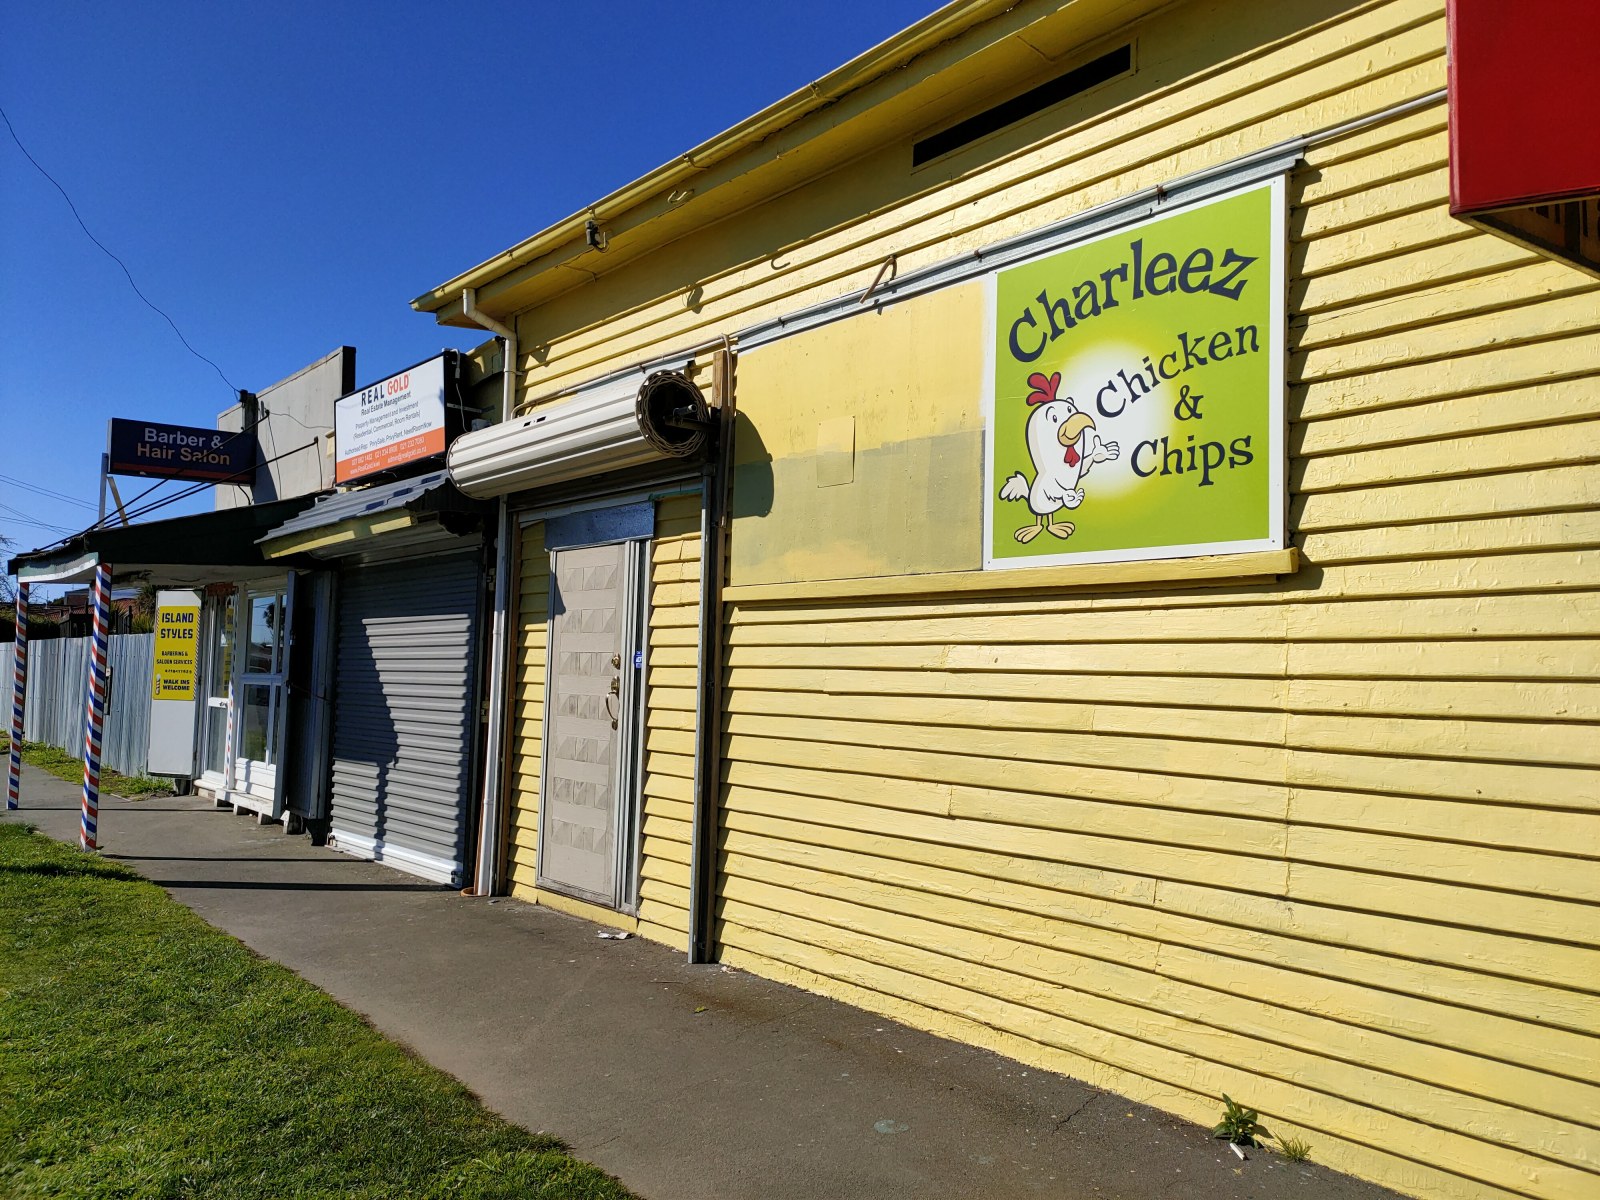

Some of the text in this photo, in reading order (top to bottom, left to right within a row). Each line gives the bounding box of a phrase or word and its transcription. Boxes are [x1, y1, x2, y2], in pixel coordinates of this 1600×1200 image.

[1009, 238, 1259, 362] Charleez
[1096, 324, 1260, 418] Chicken
[361, 373, 409, 406] REAL GOLD
[361, 391, 411, 416] Real Estate Management
[1174, 385, 1204, 421] &
[370, 412, 391, 425] Management
[144, 427, 224, 449] Barber &
[137, 442, 230, 466] Hair Salon
[1131, 435, 1254, 487] Chips
[162, 613, 194, 623] ISLAND
[161, 629, 193, 638] STYLES
